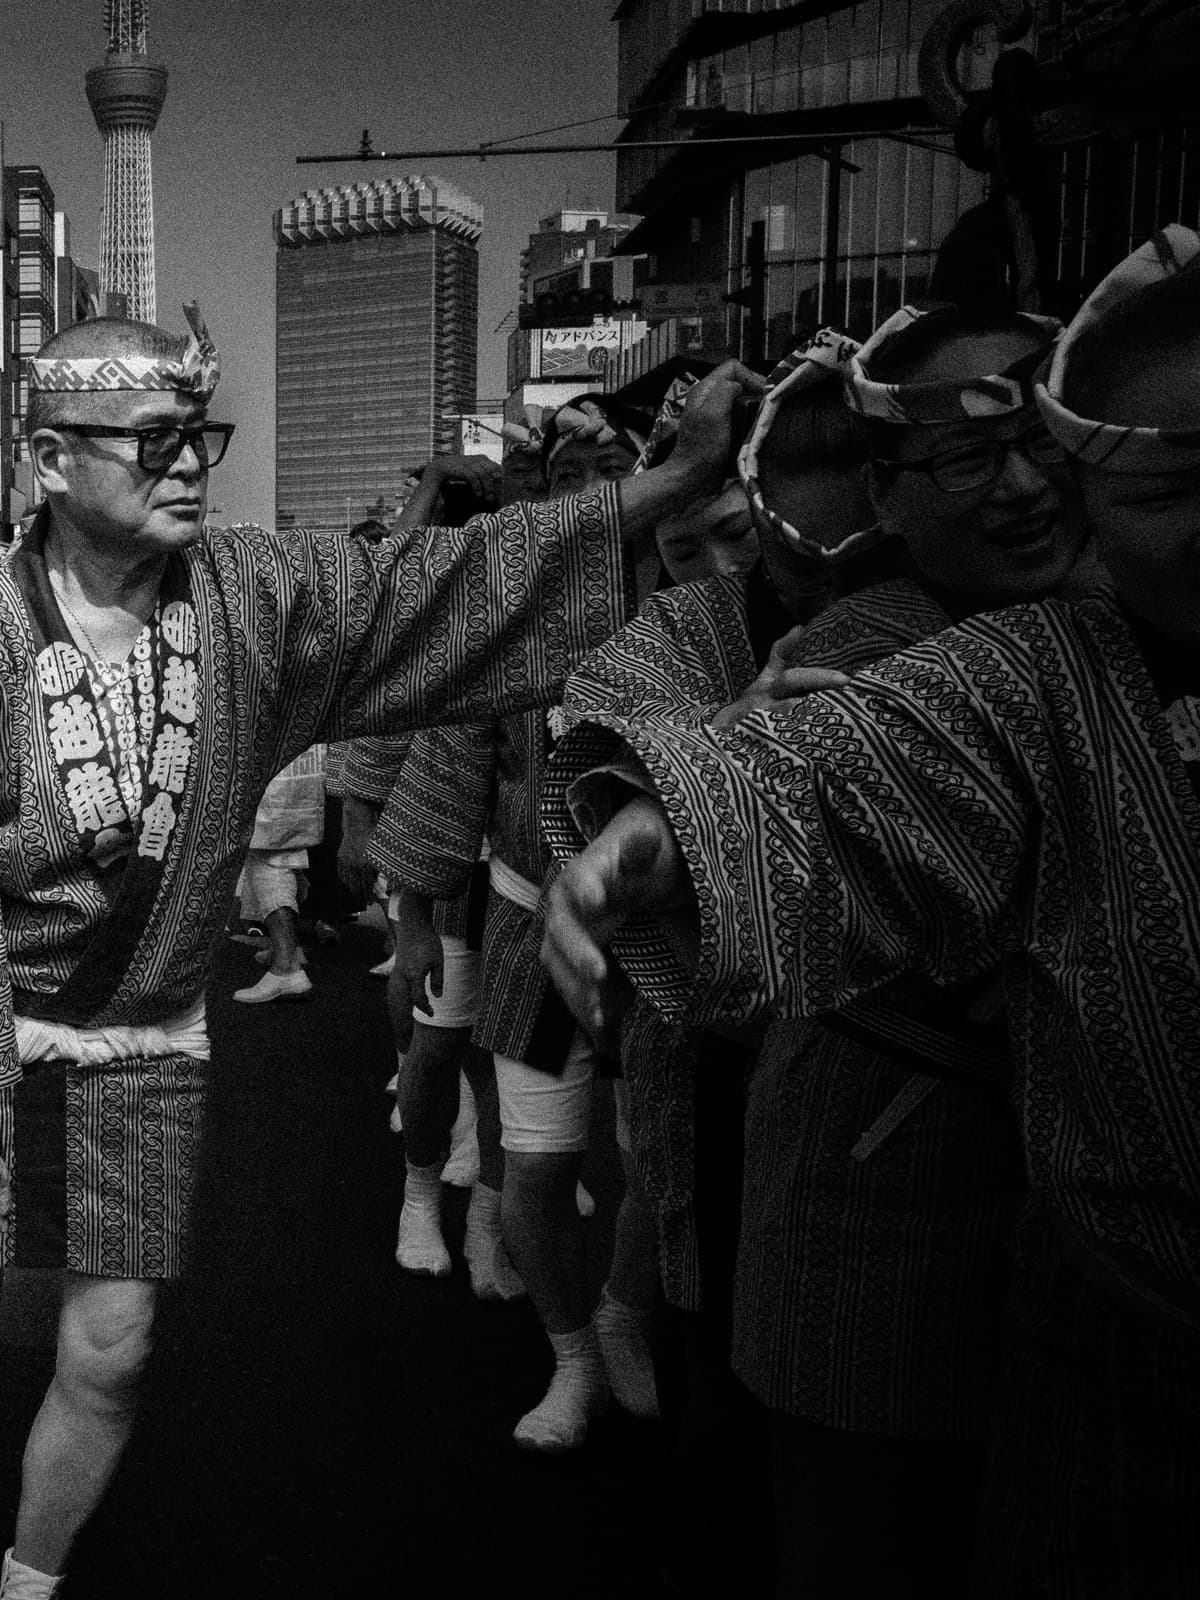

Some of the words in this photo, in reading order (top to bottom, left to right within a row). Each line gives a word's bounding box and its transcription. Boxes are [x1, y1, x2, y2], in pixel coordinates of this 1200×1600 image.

[560, 330, 618, 343] アドバンス
